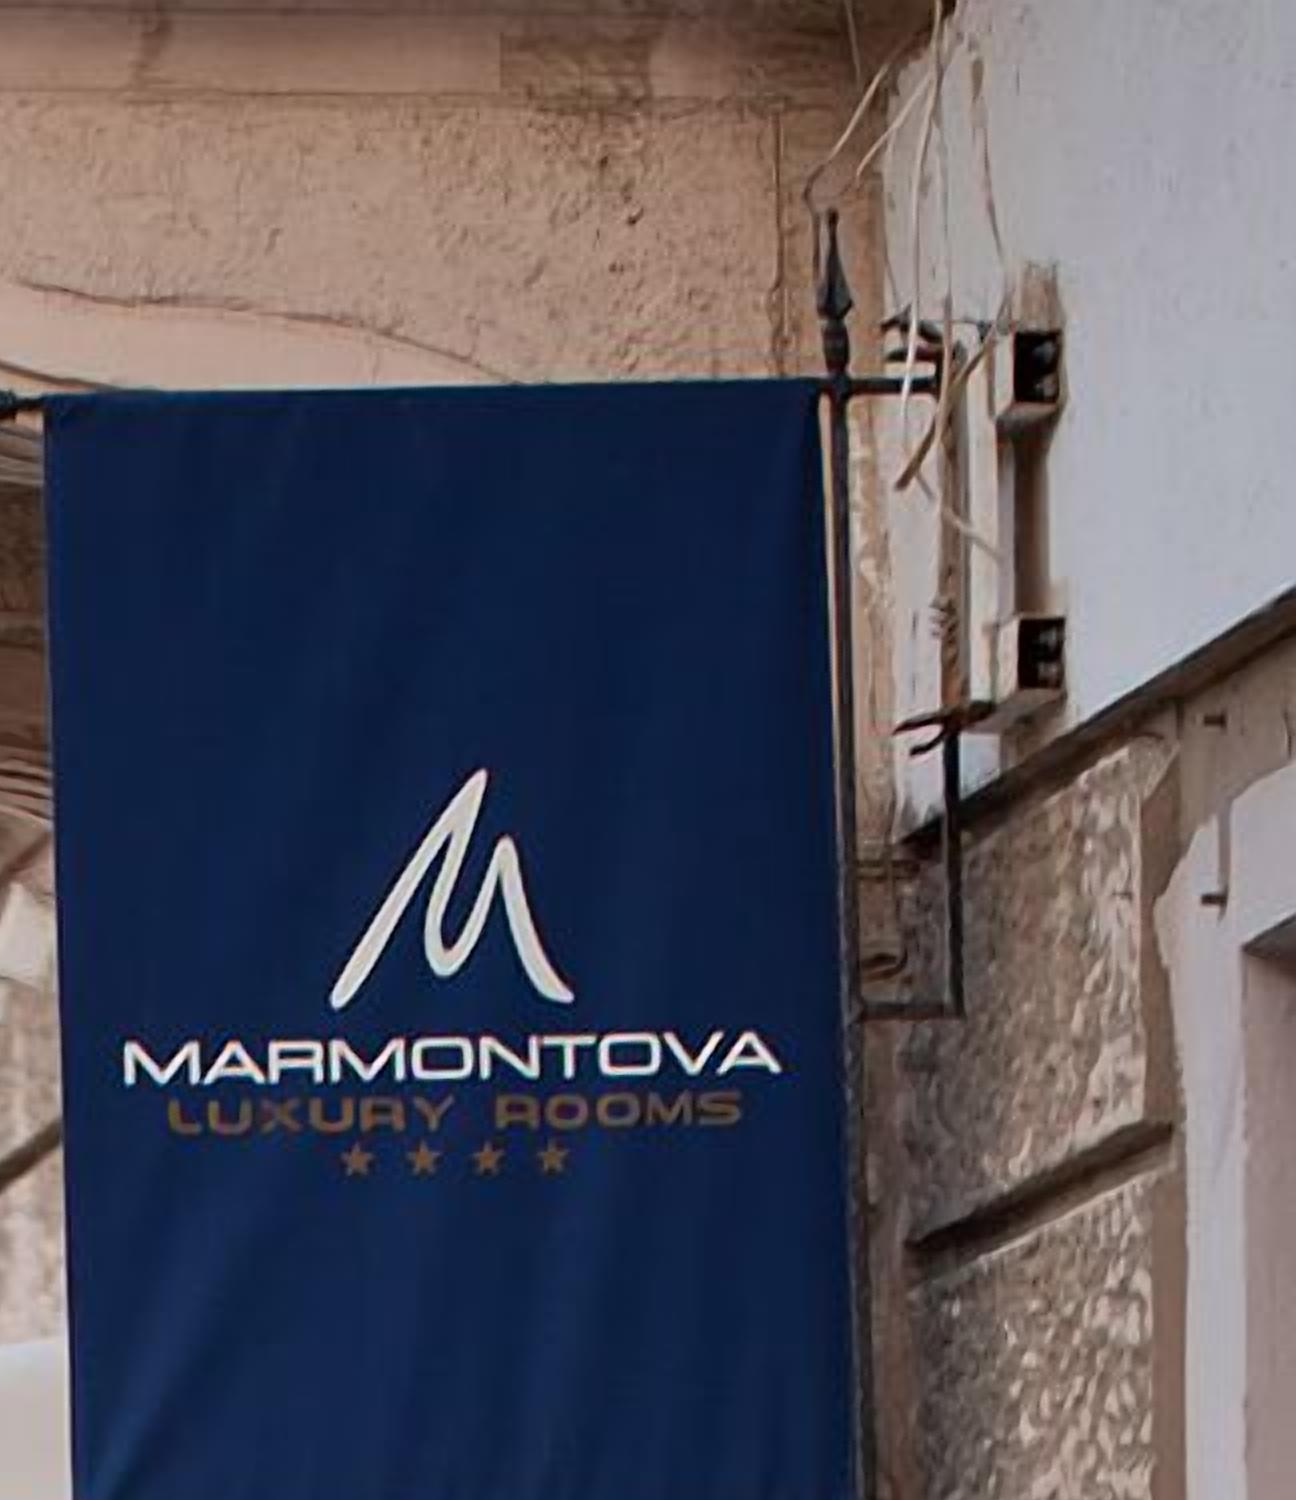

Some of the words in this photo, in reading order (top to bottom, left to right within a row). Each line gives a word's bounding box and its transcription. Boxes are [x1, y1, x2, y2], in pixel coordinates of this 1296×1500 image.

[122, 1031, 783, 1086] MARMONTOVA
[166, 1096, 456, 1135] LUXURY
[494, 1090, 744, 1130] ROOMS
